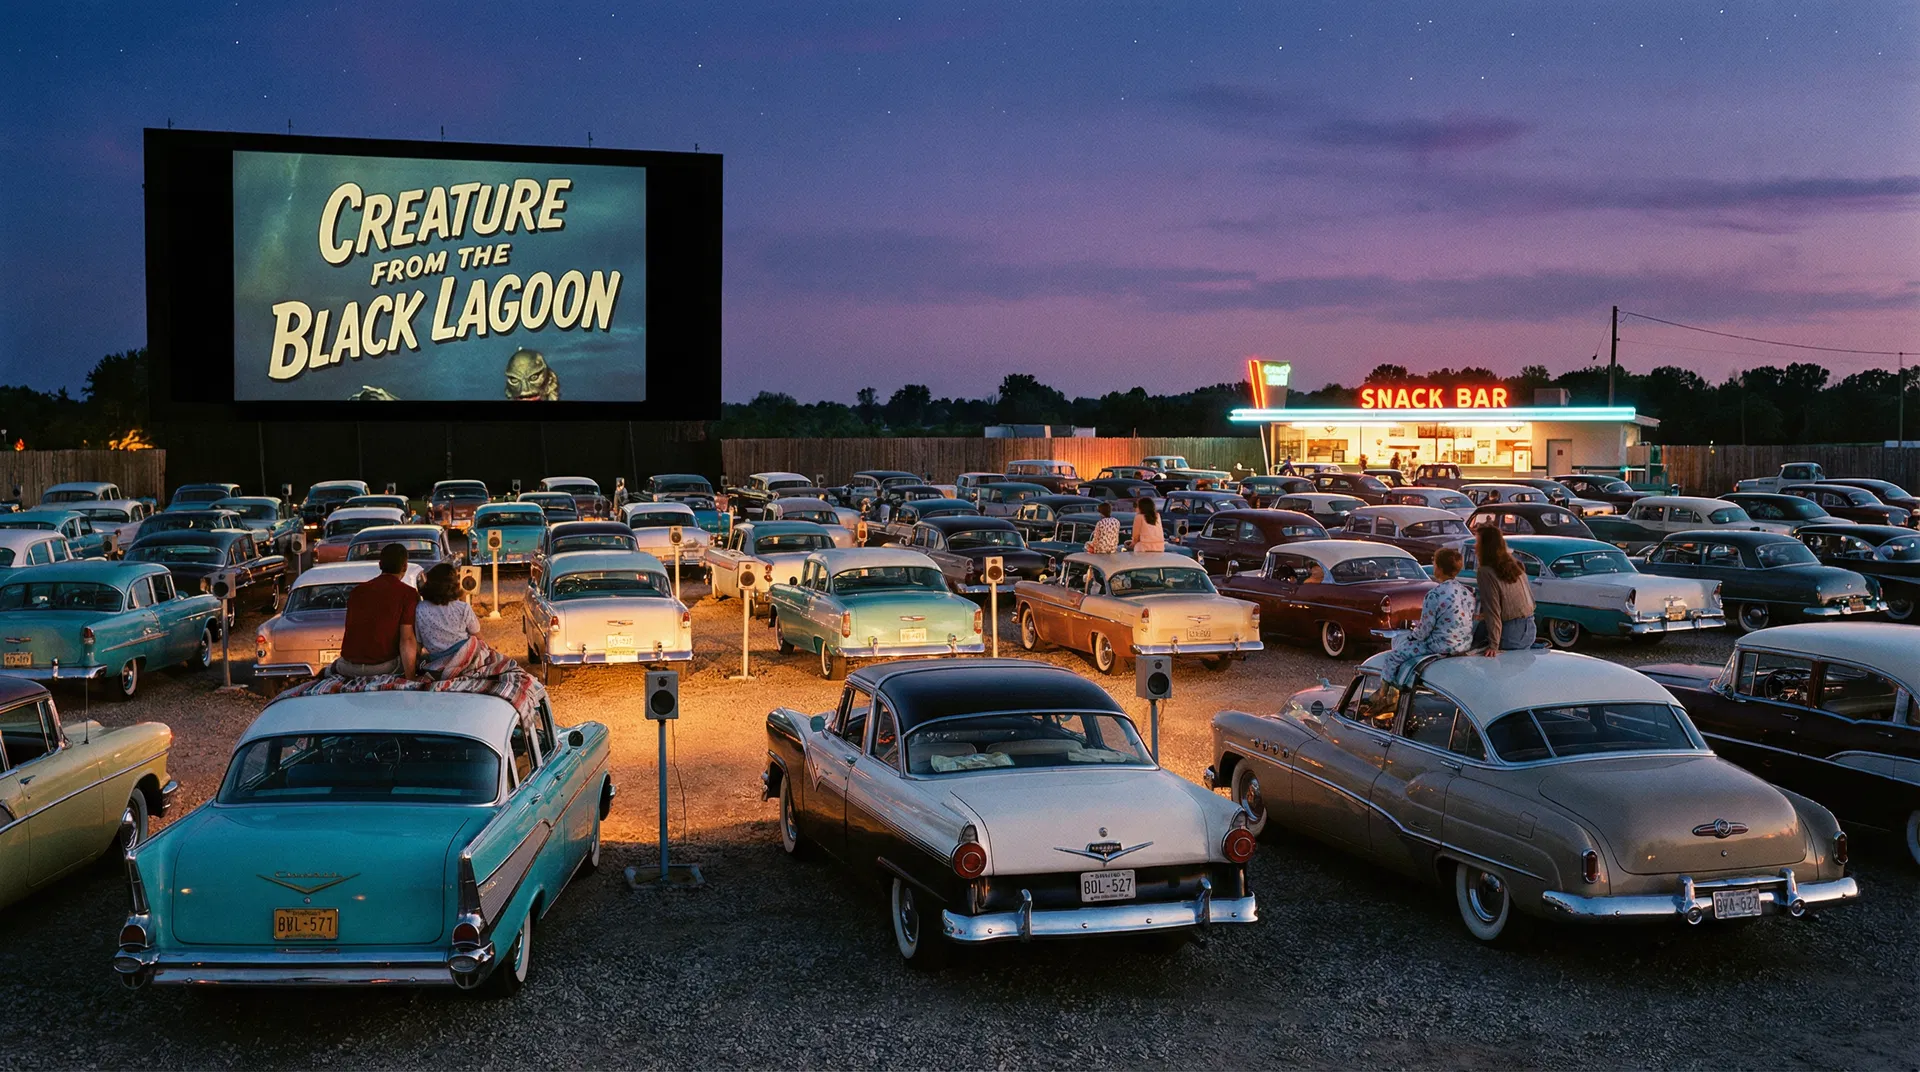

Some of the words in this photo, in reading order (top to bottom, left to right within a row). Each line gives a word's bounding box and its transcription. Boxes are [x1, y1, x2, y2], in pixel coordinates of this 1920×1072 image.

[318, 178, 572, 265] CREATURE
[370, 250, 447, 286] FROM
[457, 243, 511, 269] THE
[267, 289, 426, 380] BLACK
[430, 269, 622, 342] LAGOON
[1361, 387, 1444, 409] SNACK
[1456, 387, 1508, 409] BAR
